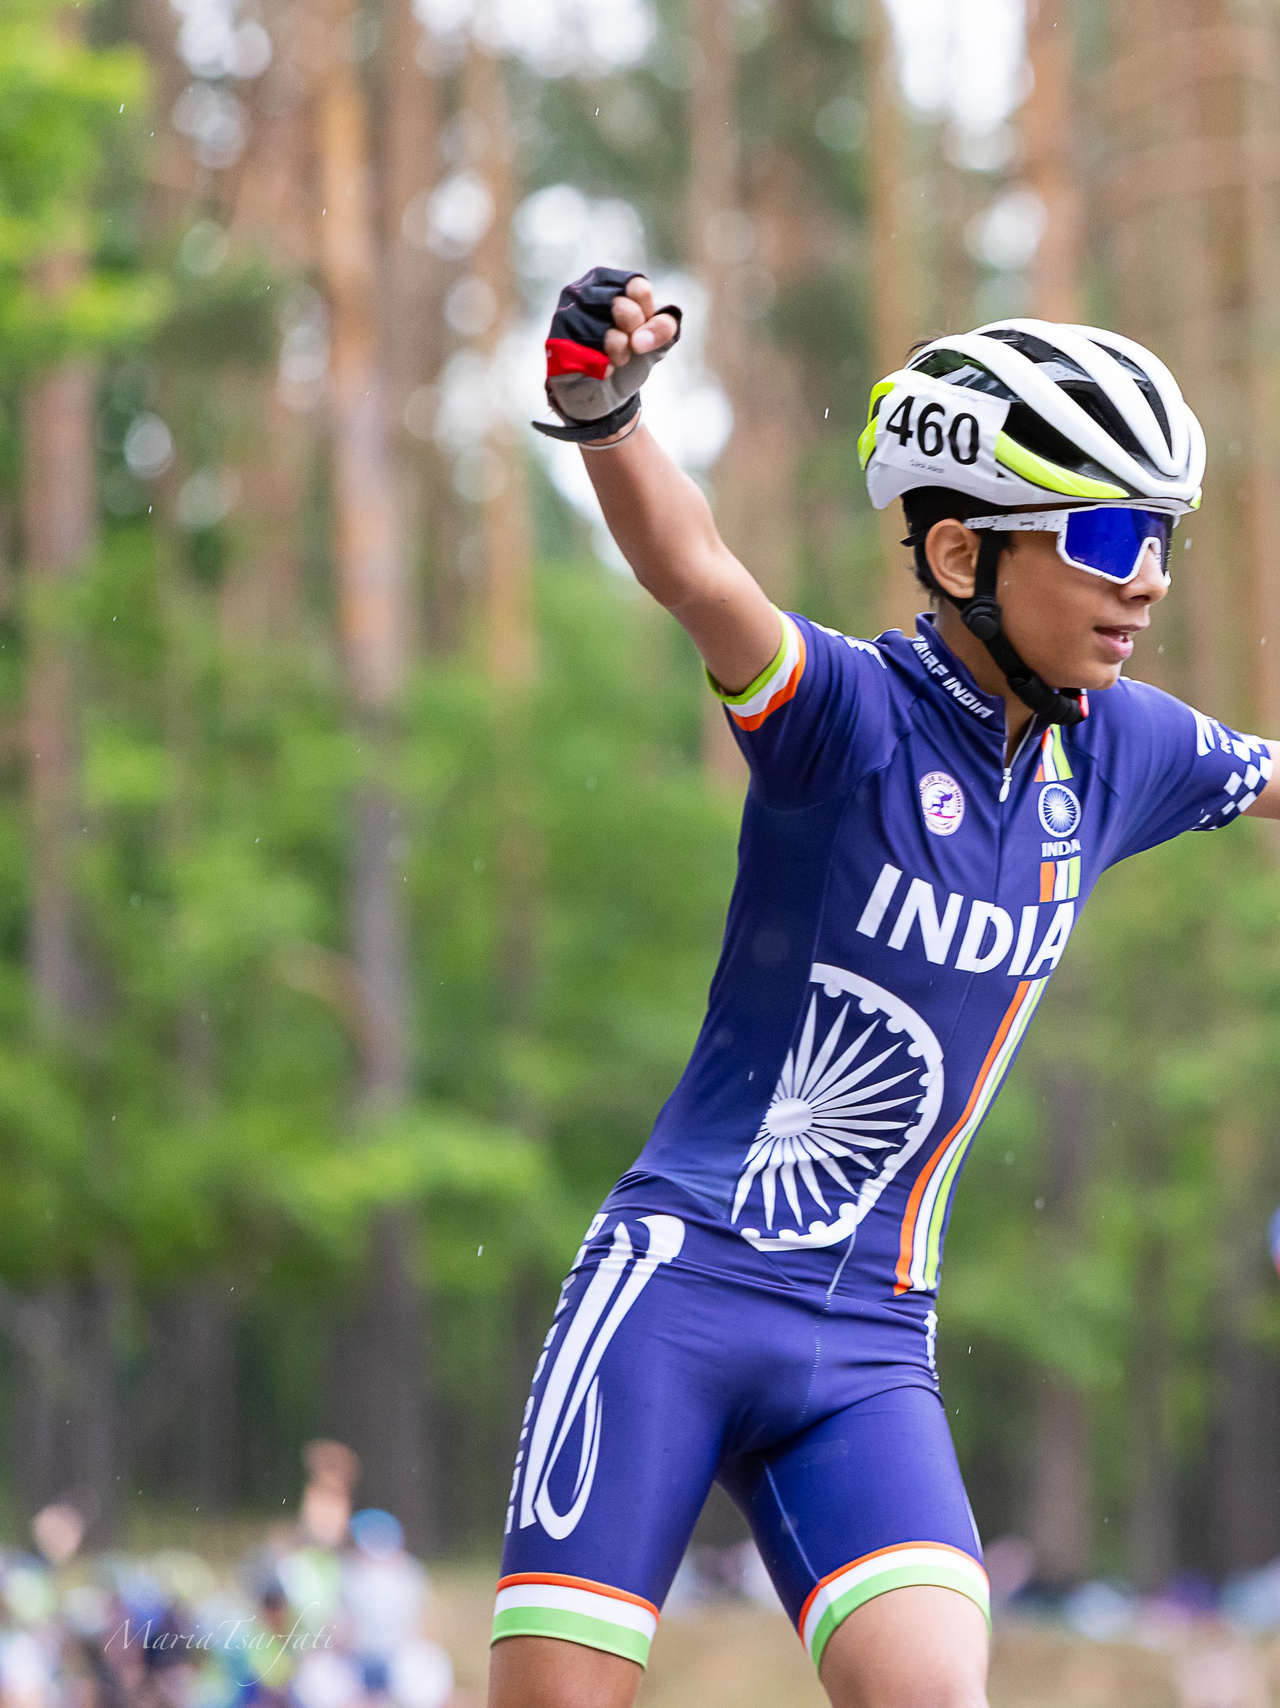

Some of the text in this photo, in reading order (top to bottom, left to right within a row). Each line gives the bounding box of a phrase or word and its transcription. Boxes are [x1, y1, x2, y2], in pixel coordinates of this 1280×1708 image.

[886, 395, 980, 466] 460
[942, 676, 995, 719] INDIA
[855, 862, 1075, 976] INDIA
